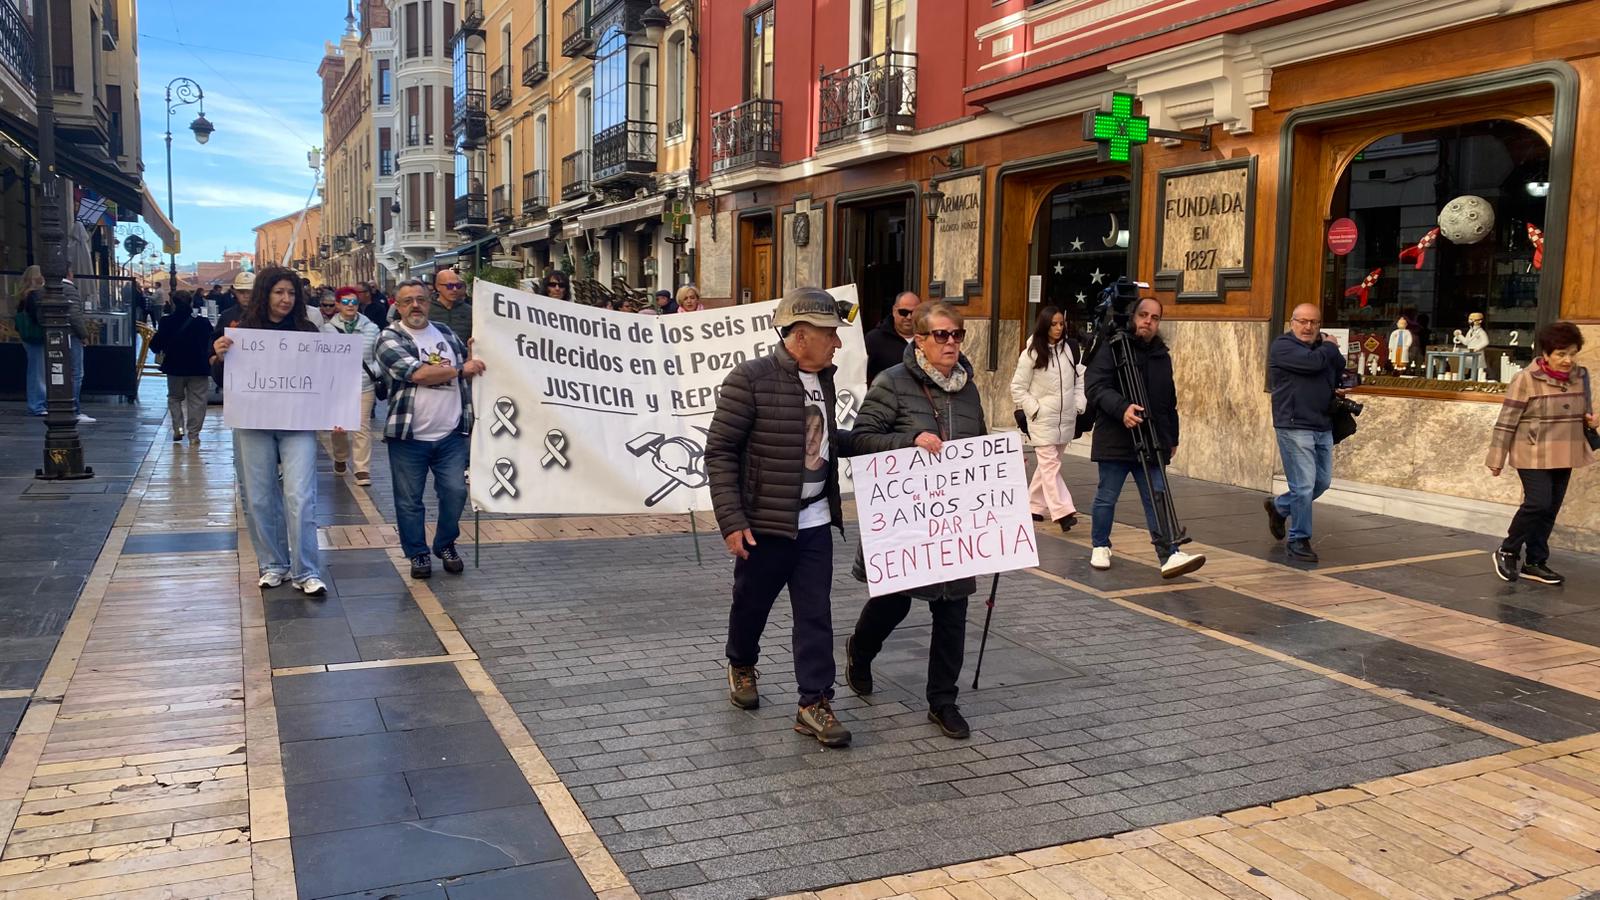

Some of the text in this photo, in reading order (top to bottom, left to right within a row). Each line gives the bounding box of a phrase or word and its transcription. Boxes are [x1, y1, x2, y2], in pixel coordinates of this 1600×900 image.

[940, 193, 979, 213] ARMACIA
[1165, 192, 1244, 219] FUNDADA
[1193, 225, 1210, 241] EN
[1185, 249, 1217, 271] 1827
[493, 292, 774, 344] En memoria de los seis m
[241, 338, 265, 352] LOS
[279, 338, 288, 351] 6
[298, 342, 310, 352] DE
[515, 333, 623, 374] fallecidos
[630, 358, 656, 375] en
[664, 355, 684, 375] el
[691, 350, 746, 374] Pozo
[247, 371, 312, 390] JUSTICIA
[543, 377, 634, 408] JUSTICIA
[646, 394, 659, 412] y
[866, 455, 900, 478] 12
[983, 438, 1018, 457] DEL
[928, 510, 998, 537] DAR LA
